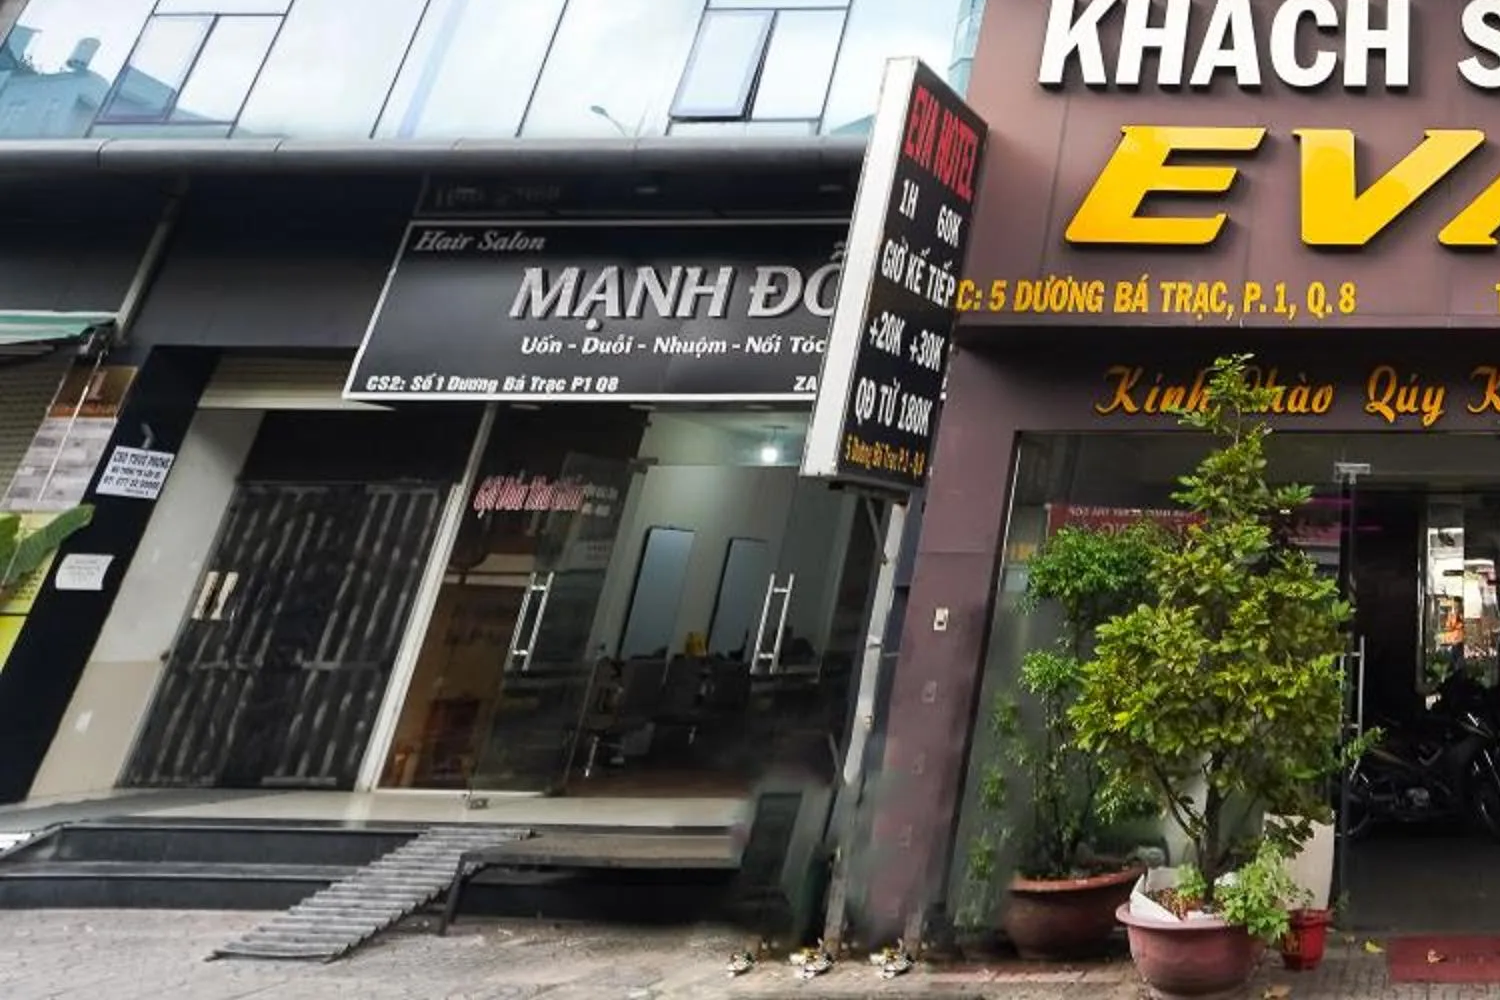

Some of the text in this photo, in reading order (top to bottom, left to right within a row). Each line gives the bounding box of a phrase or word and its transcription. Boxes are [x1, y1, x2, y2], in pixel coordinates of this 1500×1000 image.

[932, 109, 979, 202] HOTEL
[899, 178, 963, 248] 1H 60K
[414, 230, 547, 251] Hair Salon
[509, 264, 734, 331] MẠNH
[988, 280, 1007, 312] 5
[1014, 274, 1104, 313] DƯƠNG
[1114, 274, 1149, 313] BÁ
[1160, 281, 1234, 321] TRẠC,
[521, 334, 563, 354] Uốn
[653, 335, 727, 359] Nhuộm
[745, 333, 782, 354] Nối
[789, 335, 827, 354] Tóc
[571, 376, 593, 392] P1
